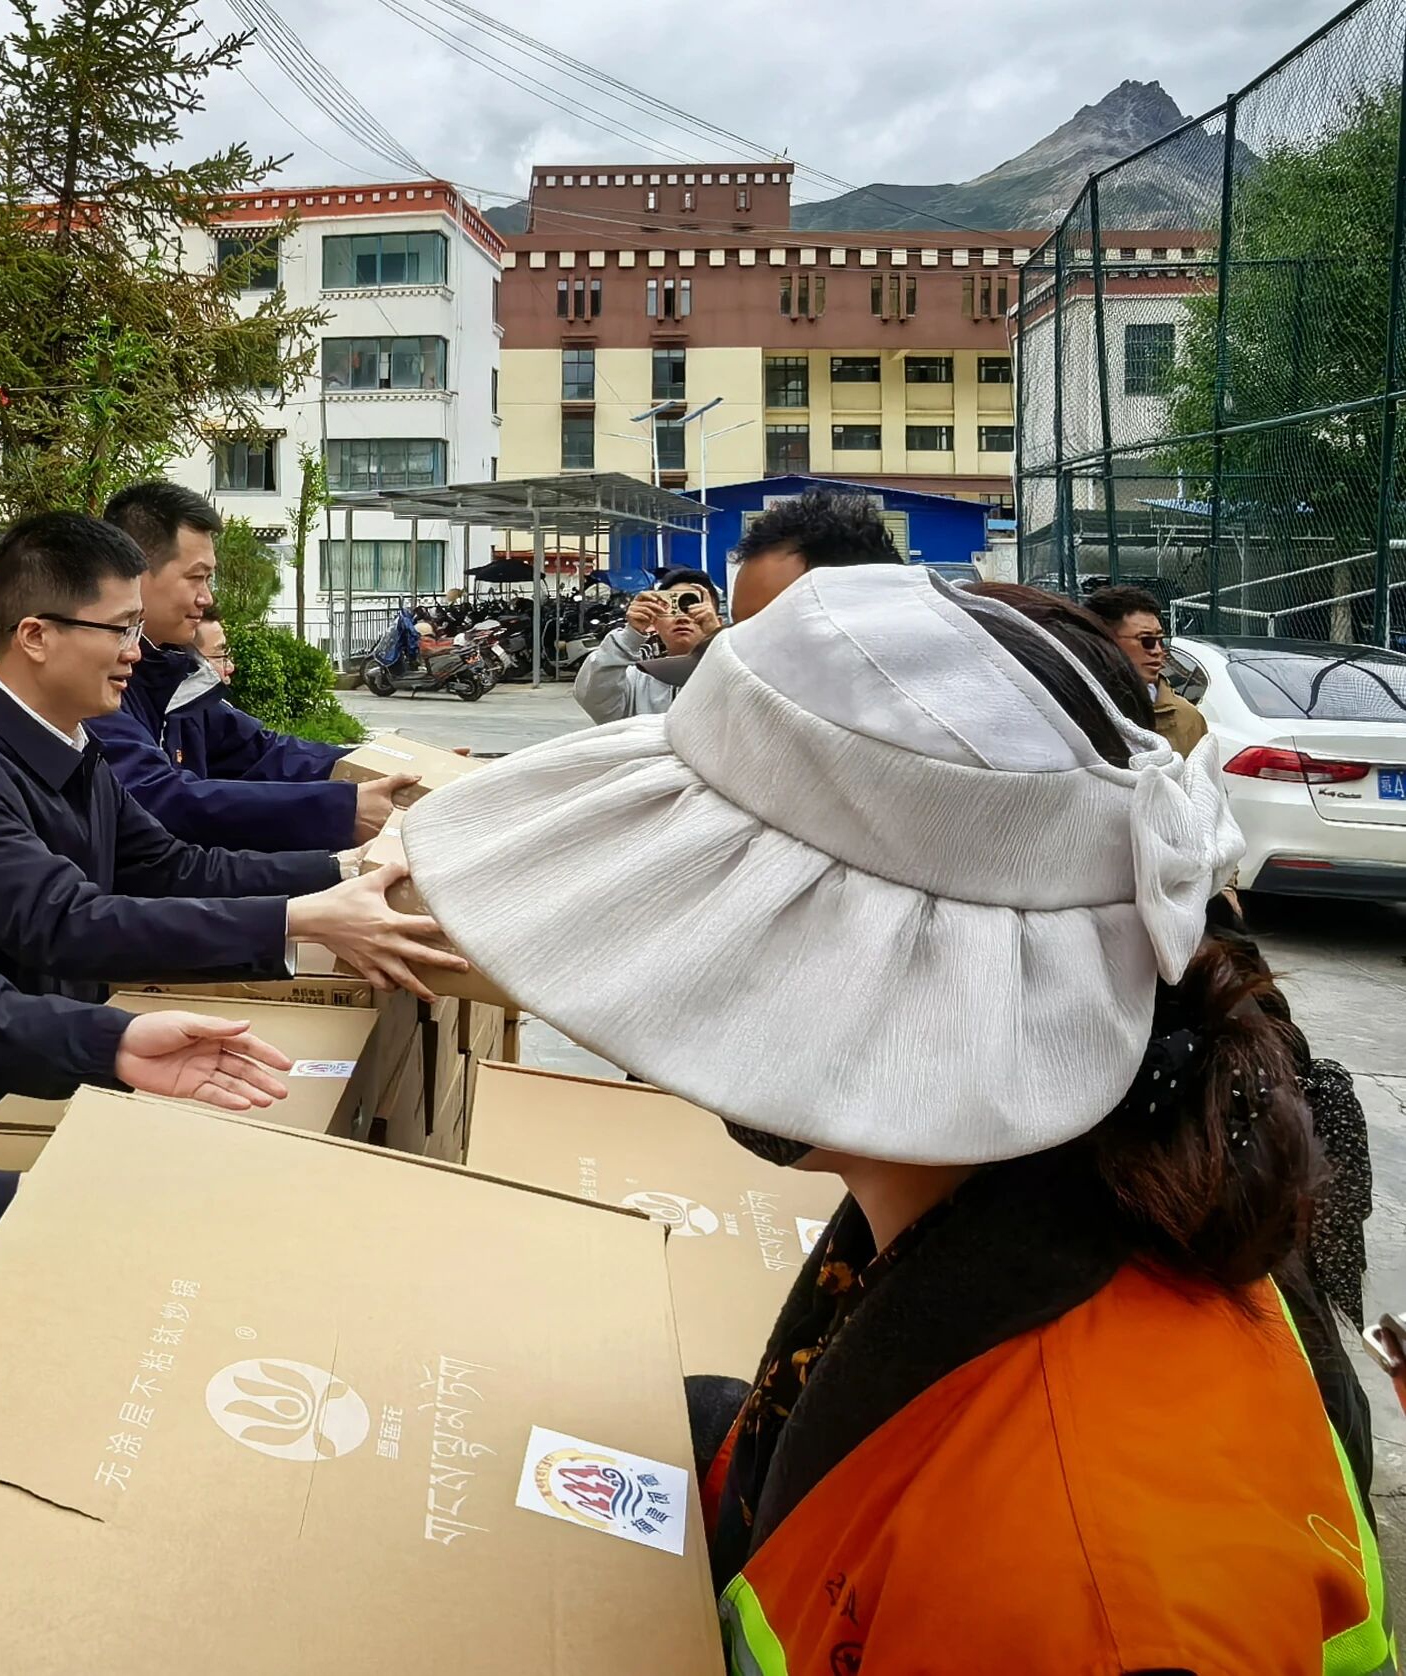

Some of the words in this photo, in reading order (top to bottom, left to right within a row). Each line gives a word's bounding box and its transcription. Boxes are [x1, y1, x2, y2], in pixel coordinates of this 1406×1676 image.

[94, 1279, 201, 1491] 无涂层不粘钛炒锅
